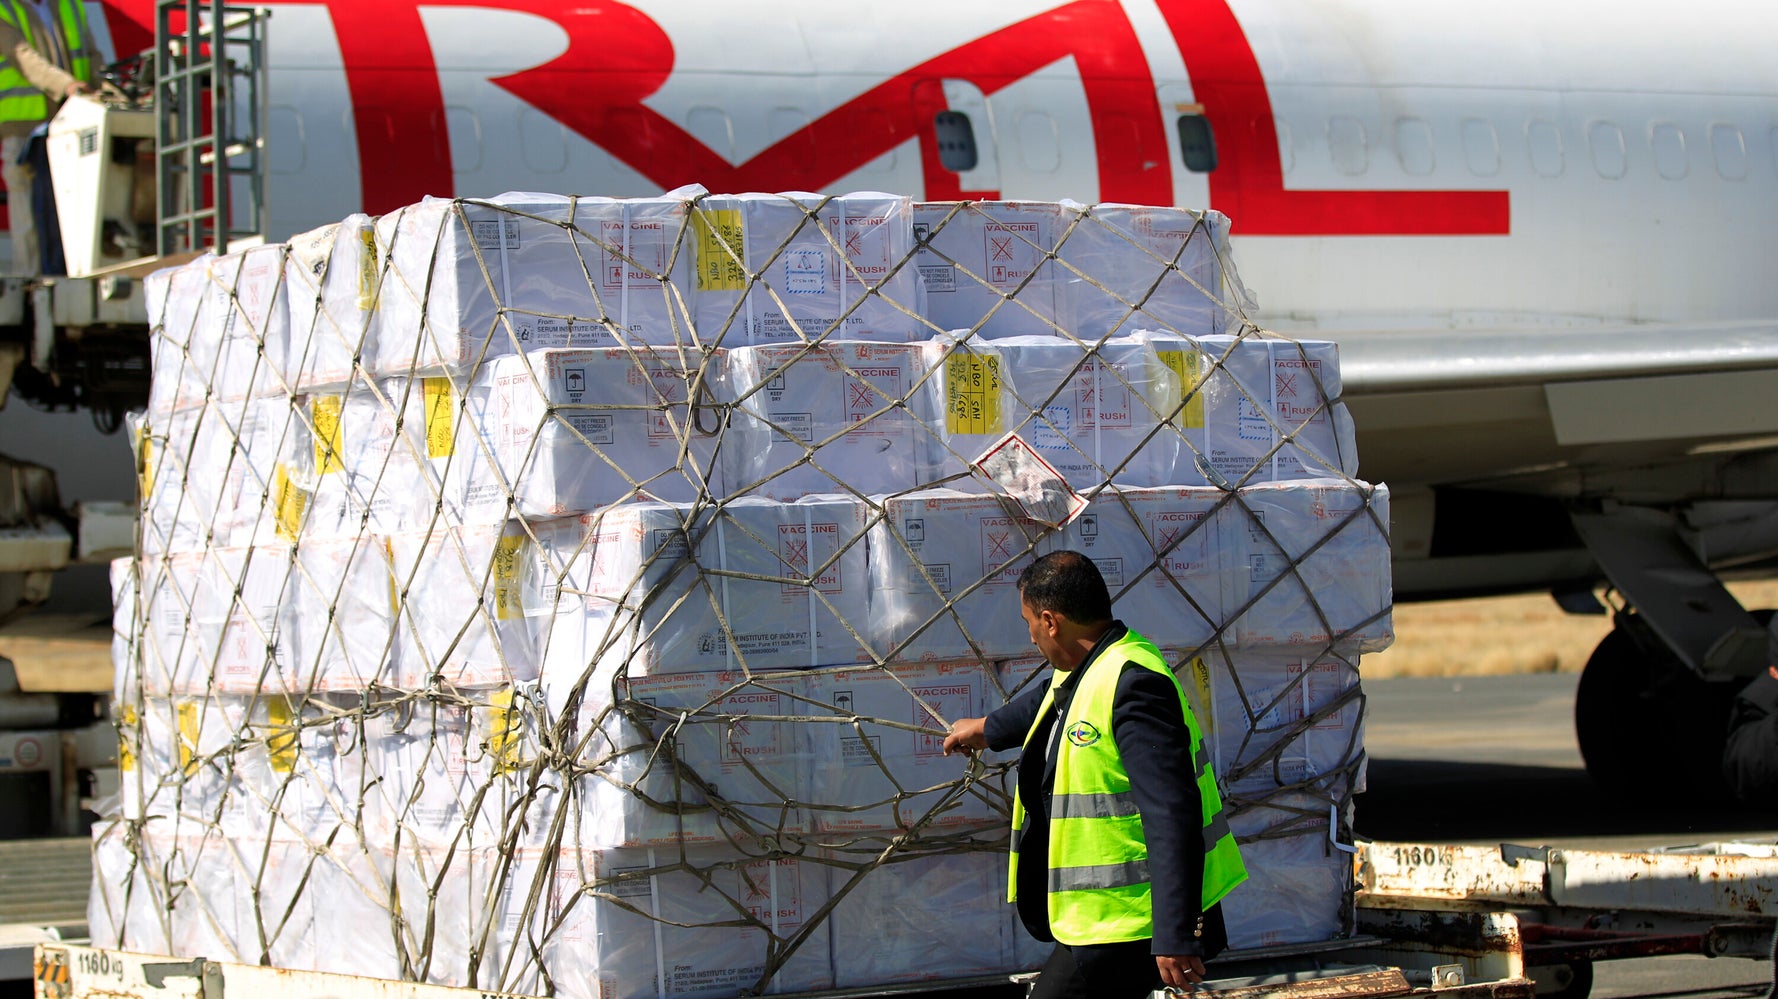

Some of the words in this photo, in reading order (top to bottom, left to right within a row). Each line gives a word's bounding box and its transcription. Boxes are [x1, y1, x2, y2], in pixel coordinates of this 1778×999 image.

[603, 222, 662, 230] VACINE
[855, 266, 887, 274] RUSH
[1007, 270, 1036, 278] RUS
[1291, 407, 1318, 415] RUS
[780, 525, 837, 534] VACCINE
[718, 635, 739, 643] SEM
[739, 634, 769, 642] INSTITUTE
[1288, 664, 1337, 673] VACINE
[914, 687, 968, 697] VACCINE
[729, 695, 777, 703] ACCINE
[743, 746, 776, 755] RUSH
[1394, 847, 1435, 866] 1160
[78, 952, 110, 975] 1160
[112, 959, 123, 981] kg
[697, 970, 727, 978] INSTITUTE
